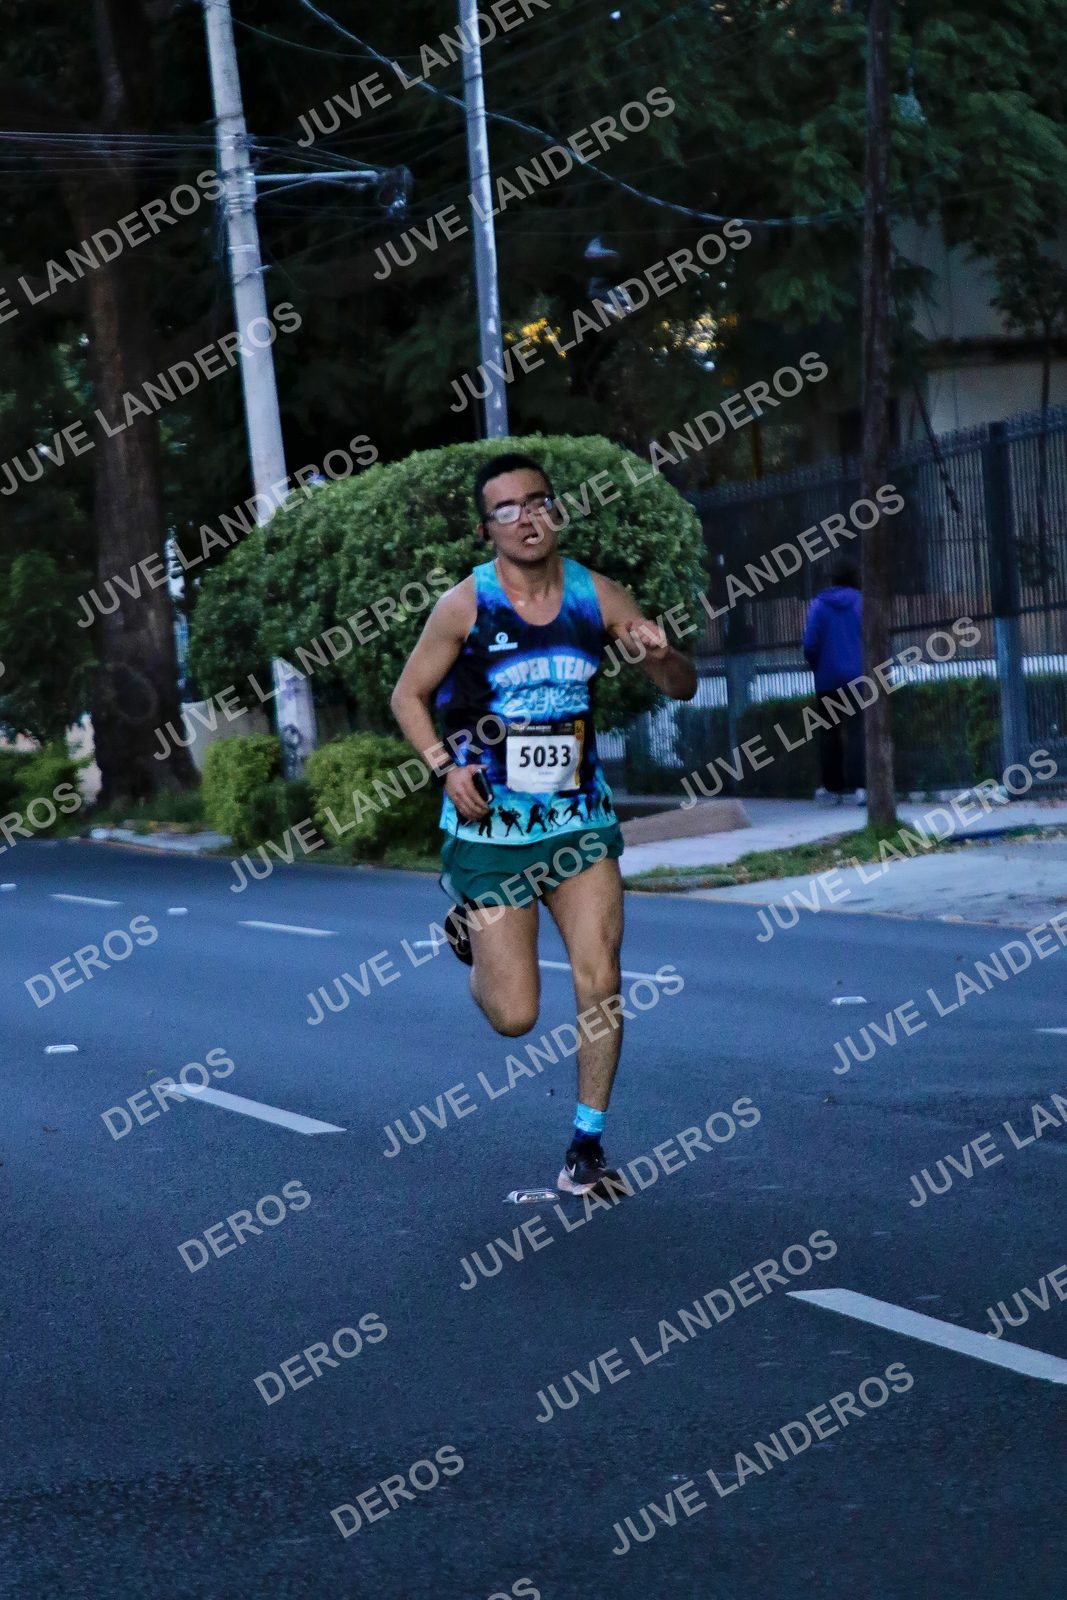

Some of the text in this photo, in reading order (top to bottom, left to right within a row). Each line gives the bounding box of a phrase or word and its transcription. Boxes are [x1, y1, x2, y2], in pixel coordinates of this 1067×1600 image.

[495, 655, 597, 688] SUPER TEAM
[519, 745, 571, 768] 5033
